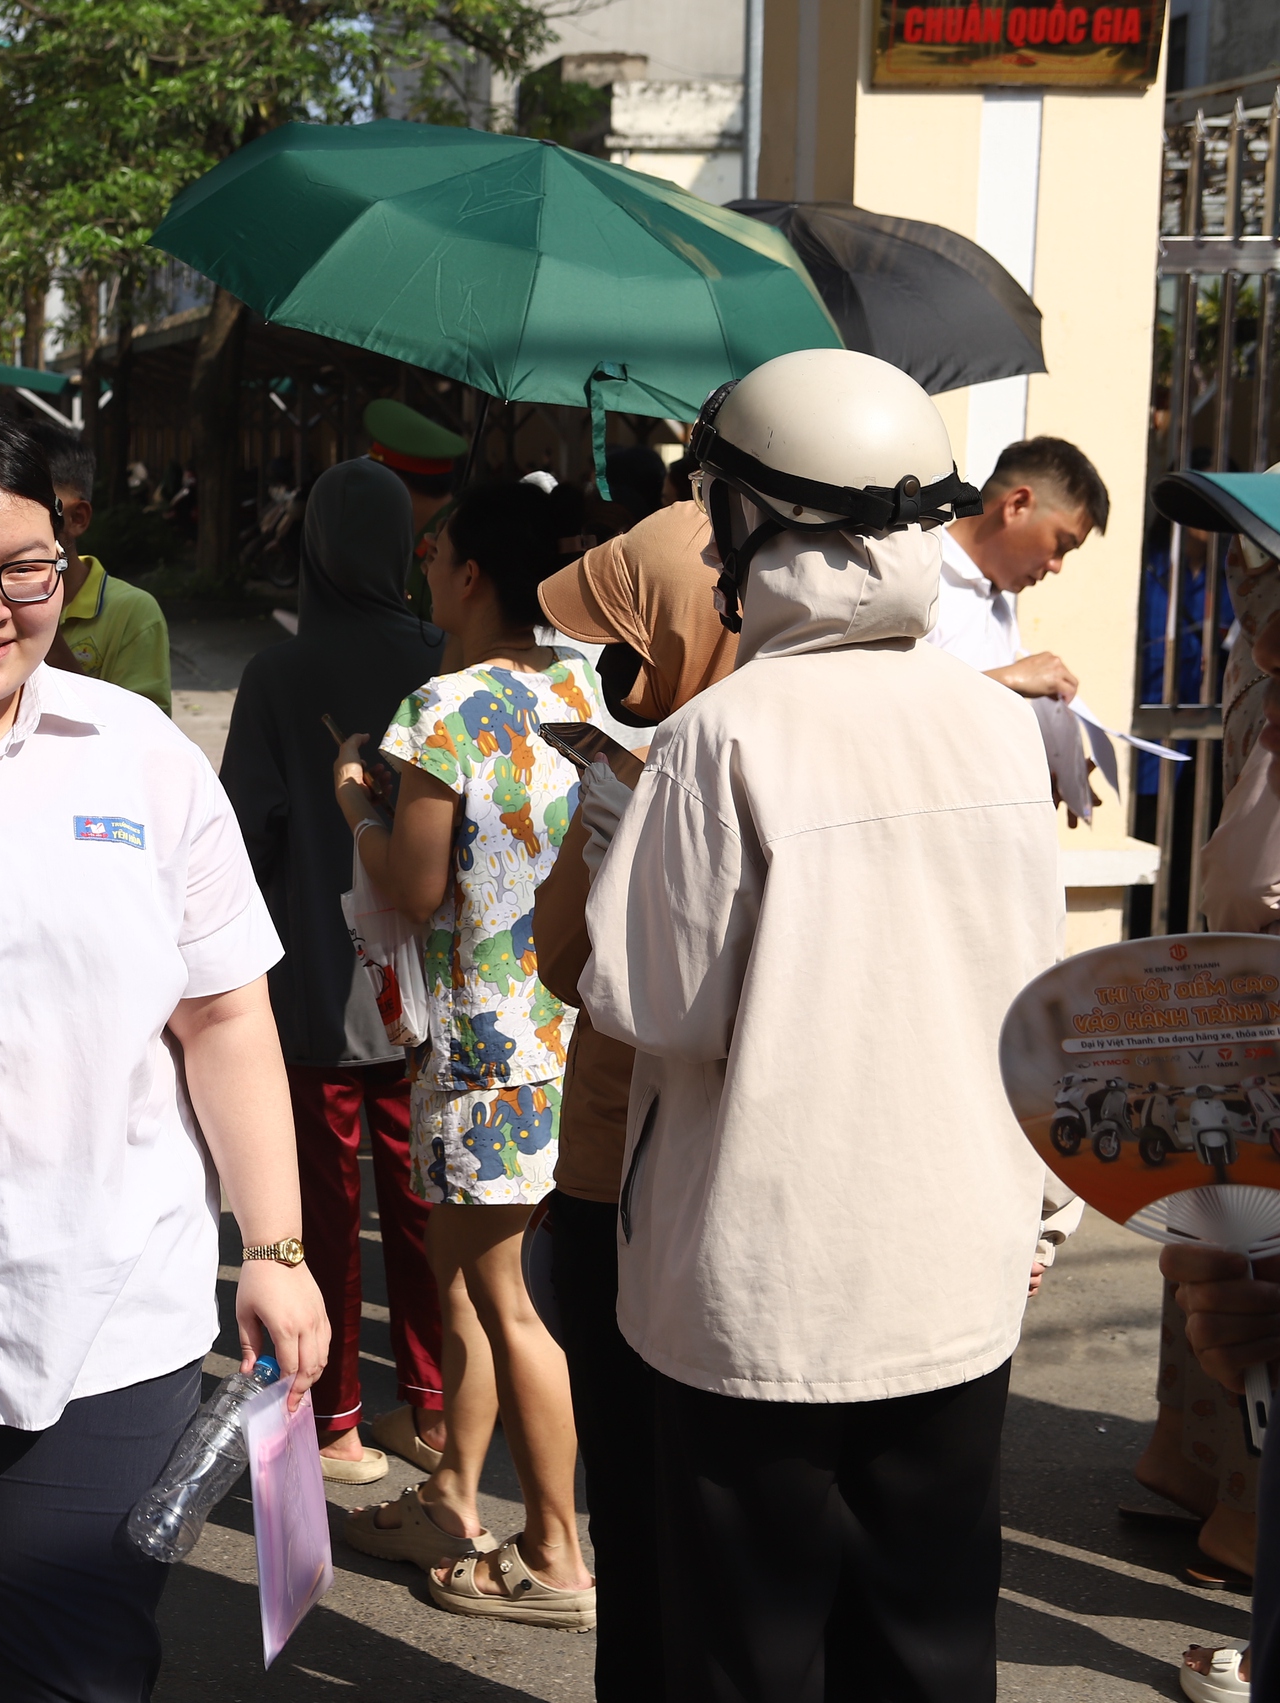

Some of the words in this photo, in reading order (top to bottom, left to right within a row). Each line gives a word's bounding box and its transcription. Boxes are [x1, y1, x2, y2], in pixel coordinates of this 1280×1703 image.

[1006, 0, 1089, 47] QUỐC
[1091, 7, 1142, 44] GIA
[1143, 966, 1154, 974] XE
[1192, 961, 1220, 970] THANH
[1094, 985, 1129, 1006] THI
[1131, 977, 1172, 1003] TỐT
[1174, 970, 1228, 1000] ĐIỂM
[1230, 973, 1279, 996] CAO
[1073, 1006, 1121, 1034] VÀO
[1124, 1003, 1190, 1031] HÀNH
[1191, 998, 1264, 1027] TRÌNH
[1080, 1039, 1096, 1050] Đại
[1097, 1039, 1105, 1049] lý
[1107, 1037, 1124, 1048] Việt
[1125, 1035, 1156, 1046] Thanh:
[1158, 1034, 1170, 1044] Đa
[1171, 1033, 1195, 1044] dạng
[1196, 1031, 1219, 1042] hãng
[1221, 1030, 1234, 1040] xe,
[1092, 1058, 1131, 1067] KYMCO
[1215, 1060, 1239, 1068] YADEA
